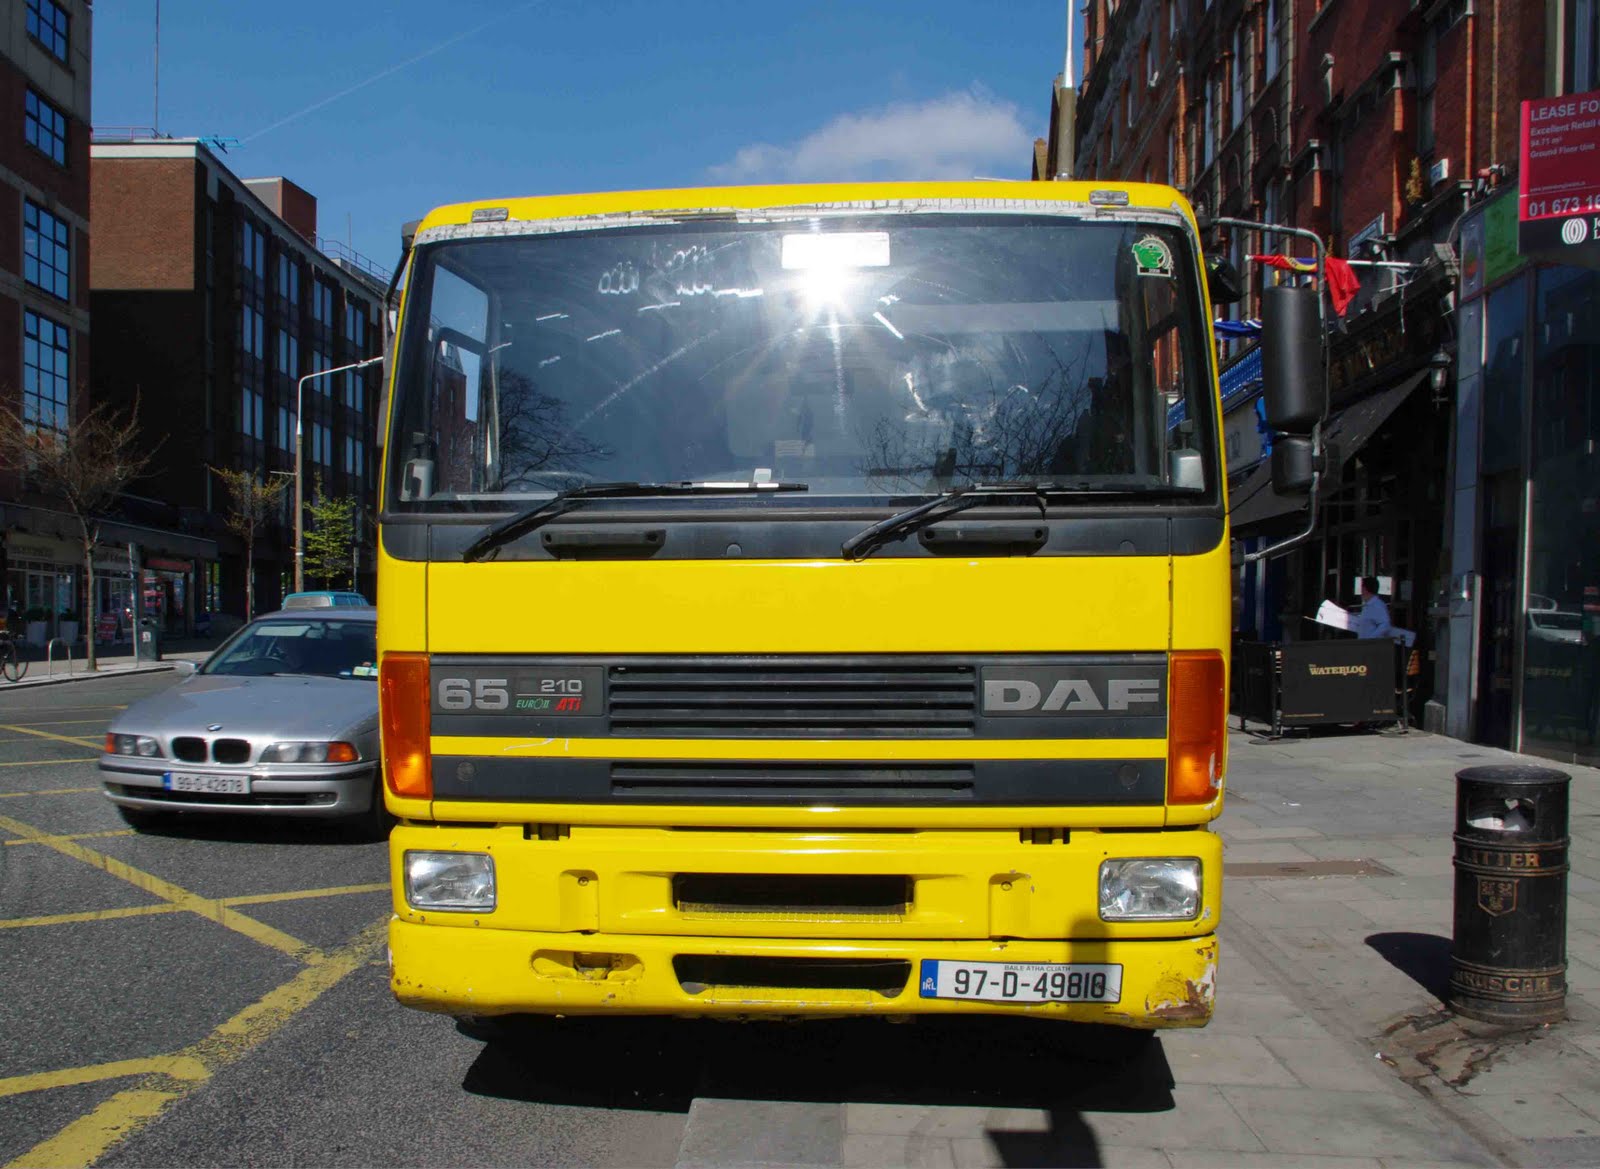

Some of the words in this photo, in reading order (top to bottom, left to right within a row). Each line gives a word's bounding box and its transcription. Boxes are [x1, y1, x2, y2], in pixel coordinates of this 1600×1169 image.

[1531, 103, 1575, 121] LEASE
[1580, 100, 1600, 114] FO
[1530, 124, 1569, 137] Excellent
[1571, 118, 1596, 131] Retail
[1530, 148, 1558, 159] Ground
[1559, 146, 1579, 155] Floor
[1580, 143, 1596, 152] Unit
[1528, 200, 1546, 217] 01
[1552, 196, 1580, 215] 673
[1309, 666, 1367, 676] WATERLOO
[438, 678, 509, 711] 65
[541, 679, 582, 693] 210
[983, 679, 1161, 711] DAF
[922, 981, 937, 991] IRL
